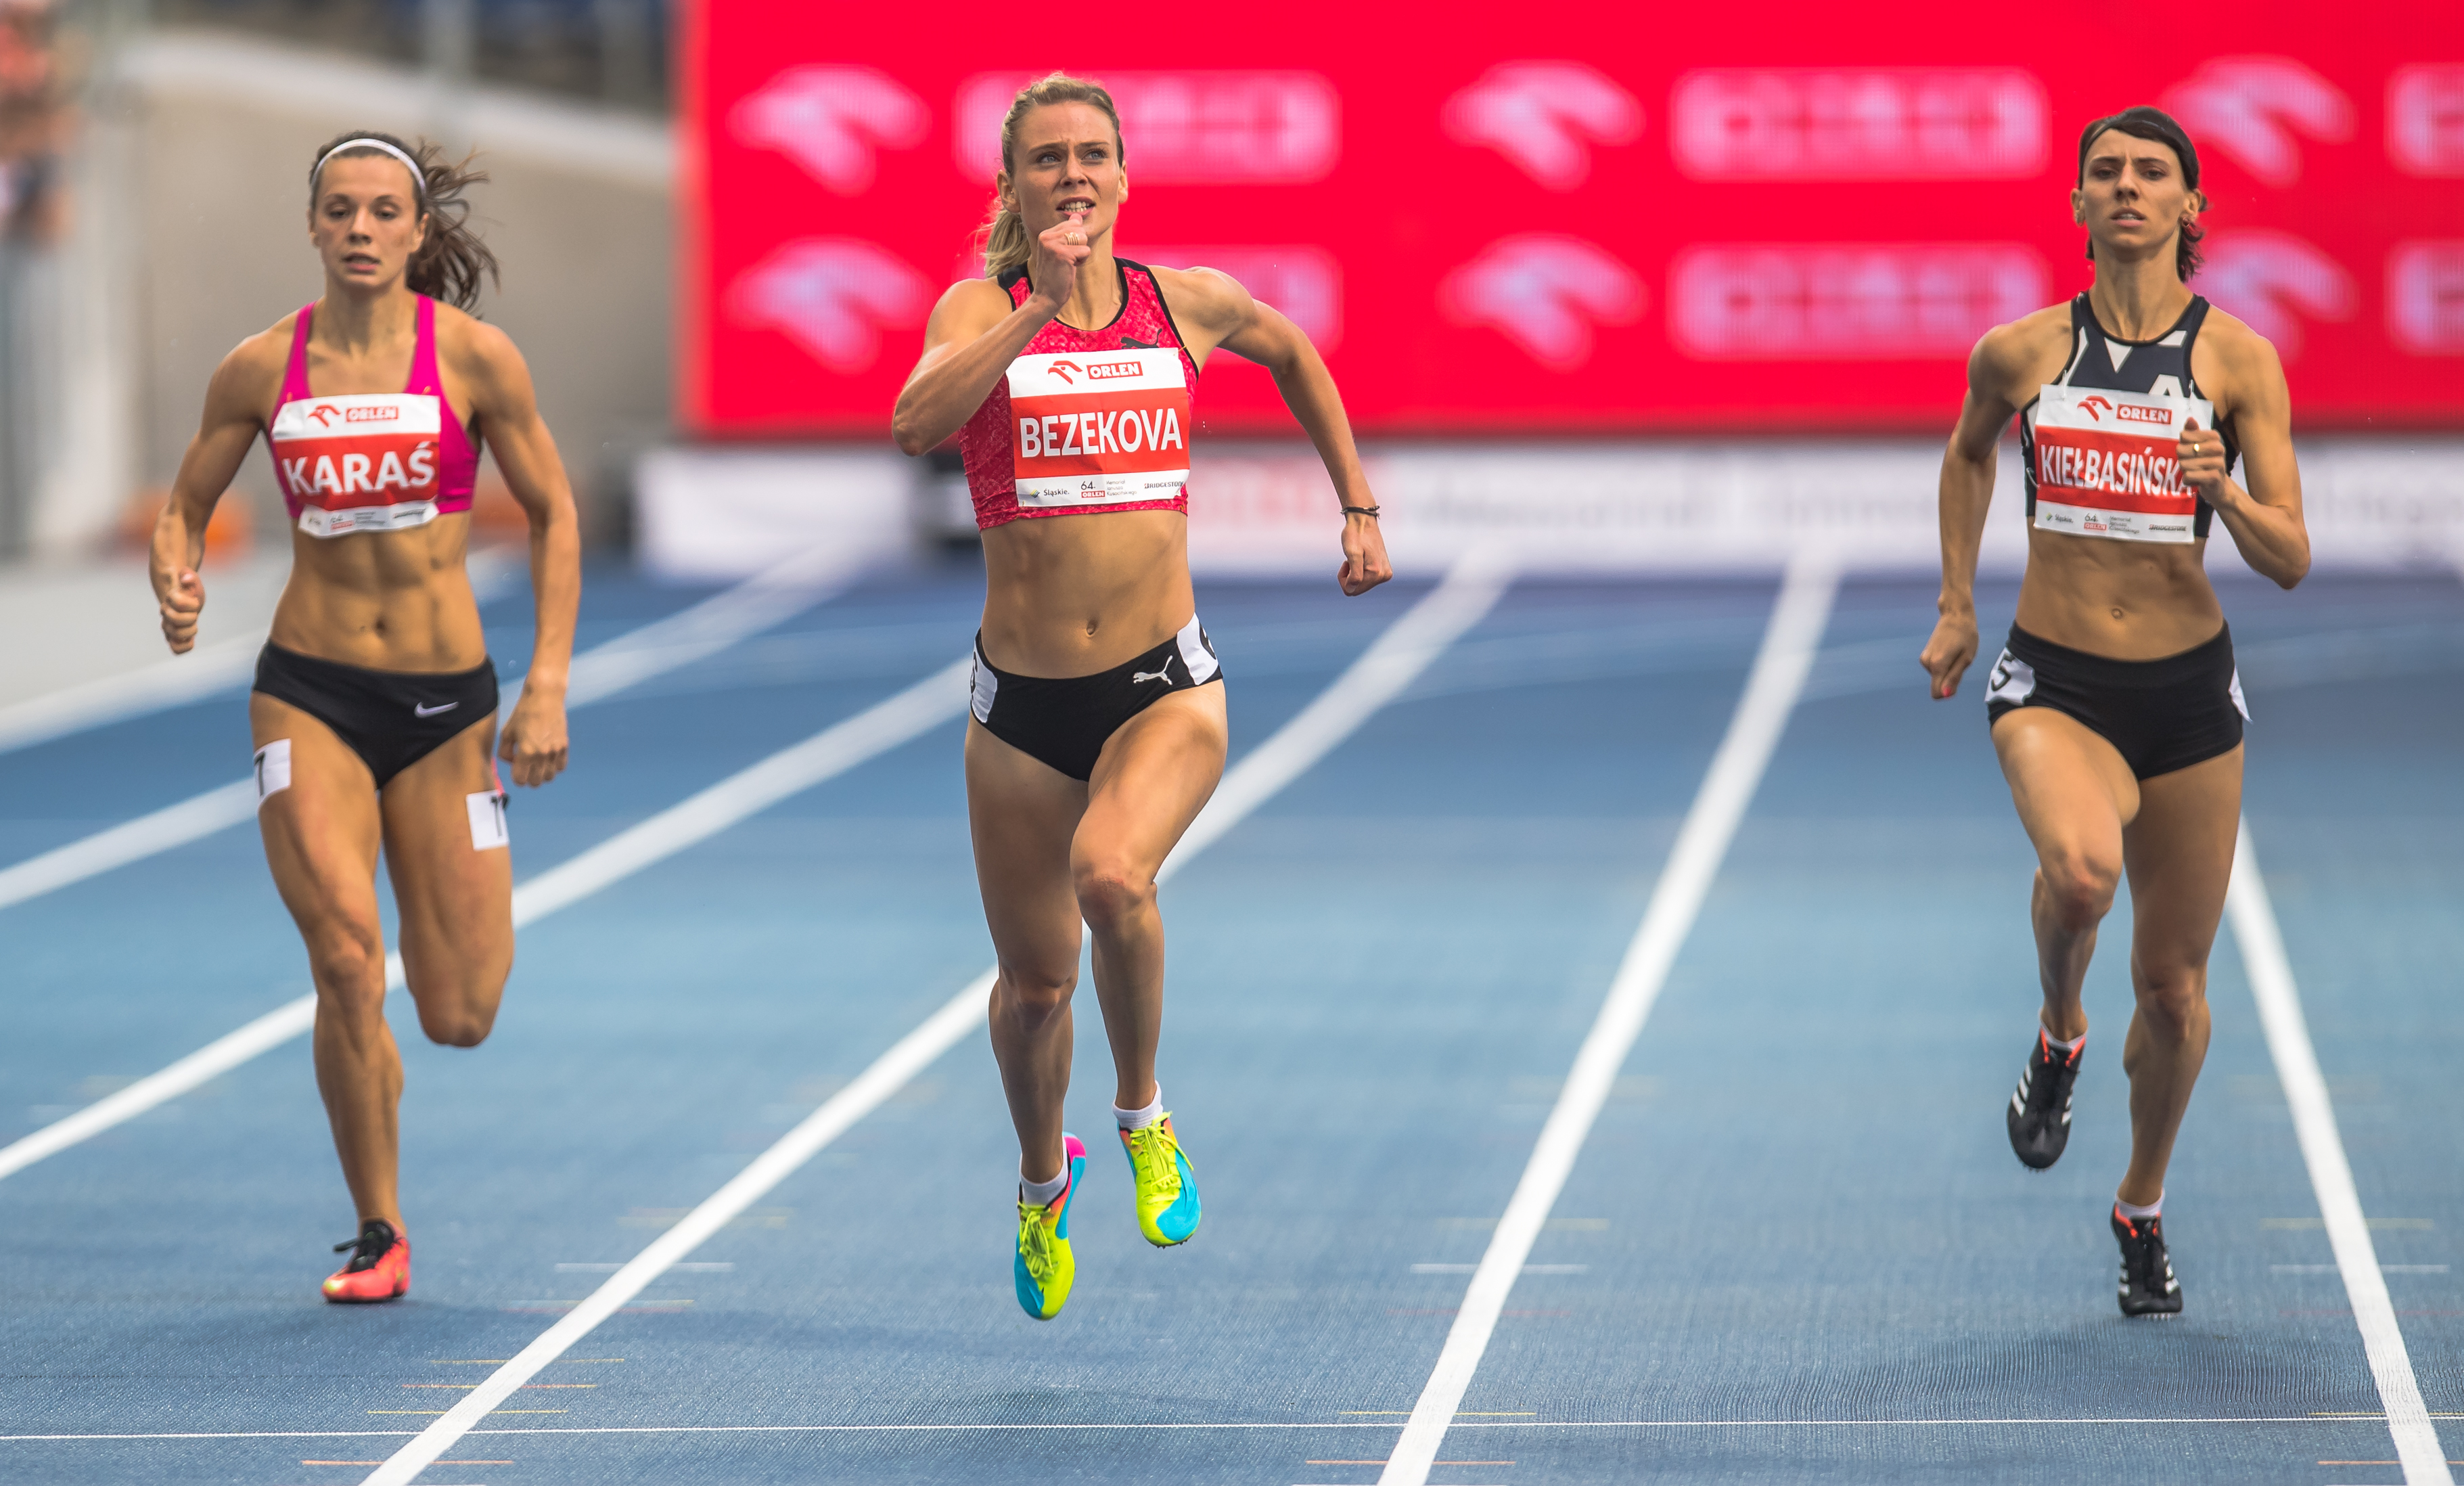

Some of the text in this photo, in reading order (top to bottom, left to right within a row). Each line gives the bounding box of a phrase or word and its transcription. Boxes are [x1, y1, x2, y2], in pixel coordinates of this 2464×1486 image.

[1090, 363, 1140, 378] ORLEN
[348, 407, 397, 422] ORLEN
[2119, 405, 2169, 423] ORLEN
[1020, 408, 1183, 458] BEZEKOVA
[281, 441, 435, 495] KARAŚ
[1991, 653, 2015, 692] 5
